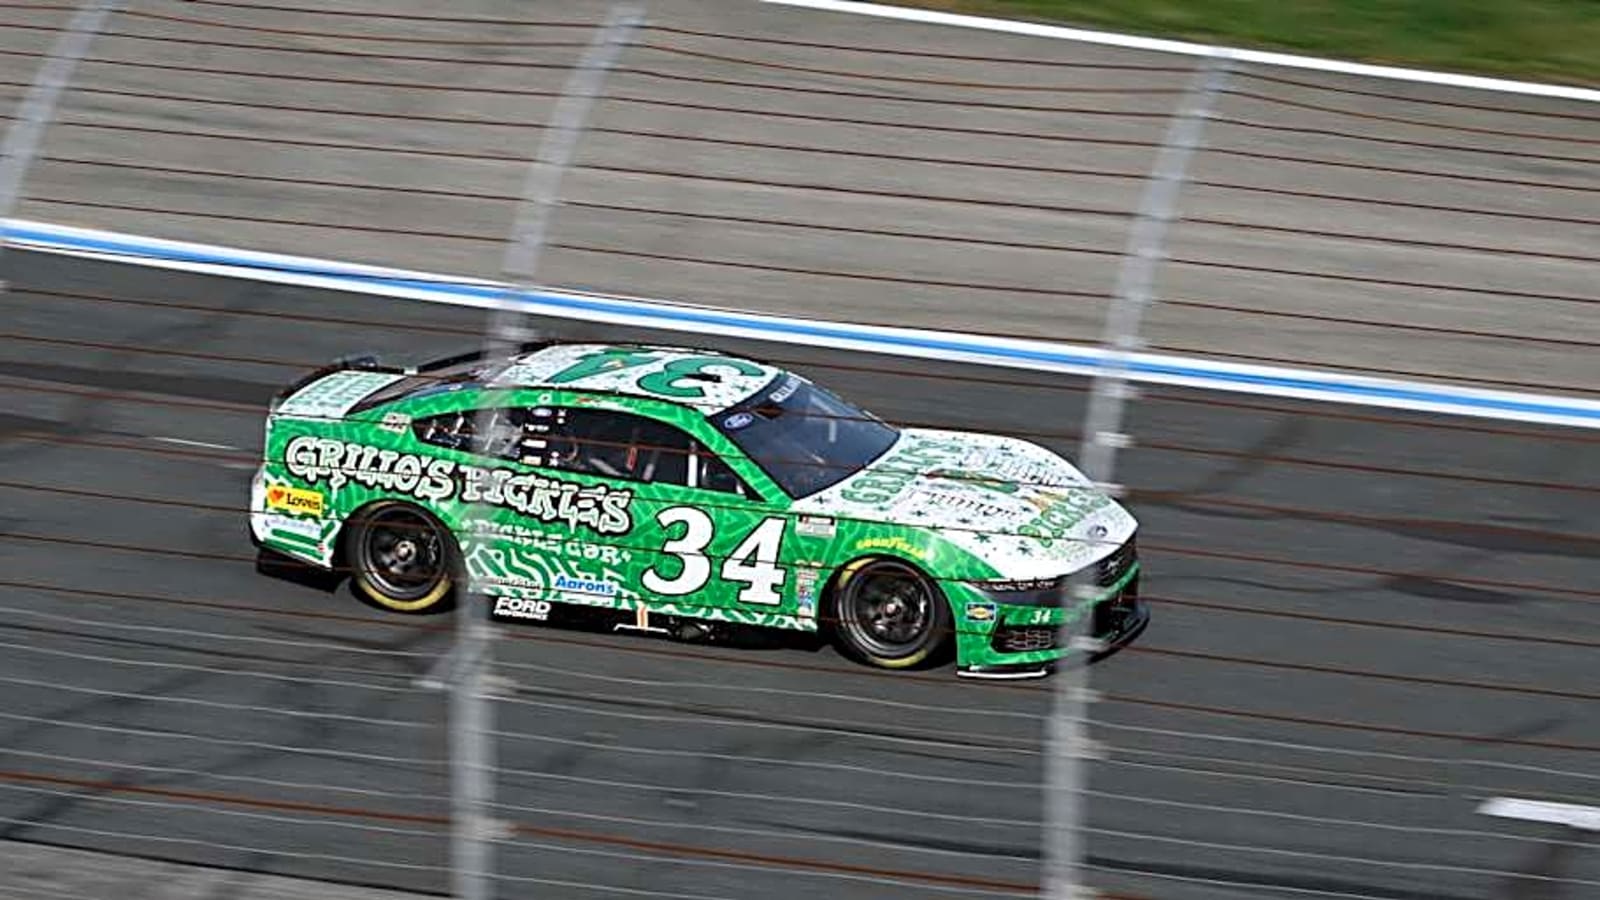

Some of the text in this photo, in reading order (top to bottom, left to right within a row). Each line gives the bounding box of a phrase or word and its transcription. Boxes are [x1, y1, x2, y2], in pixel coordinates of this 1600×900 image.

[543, 349, 766, 398] 34
[284, 435, 456, 500] GRILLO'S
[457, 463, 632, 535] PICKLES
[641, 504, 787, 607] 34
[495, 596, 552, 615] FORD
[1030, 609, 1052, 625] 34
